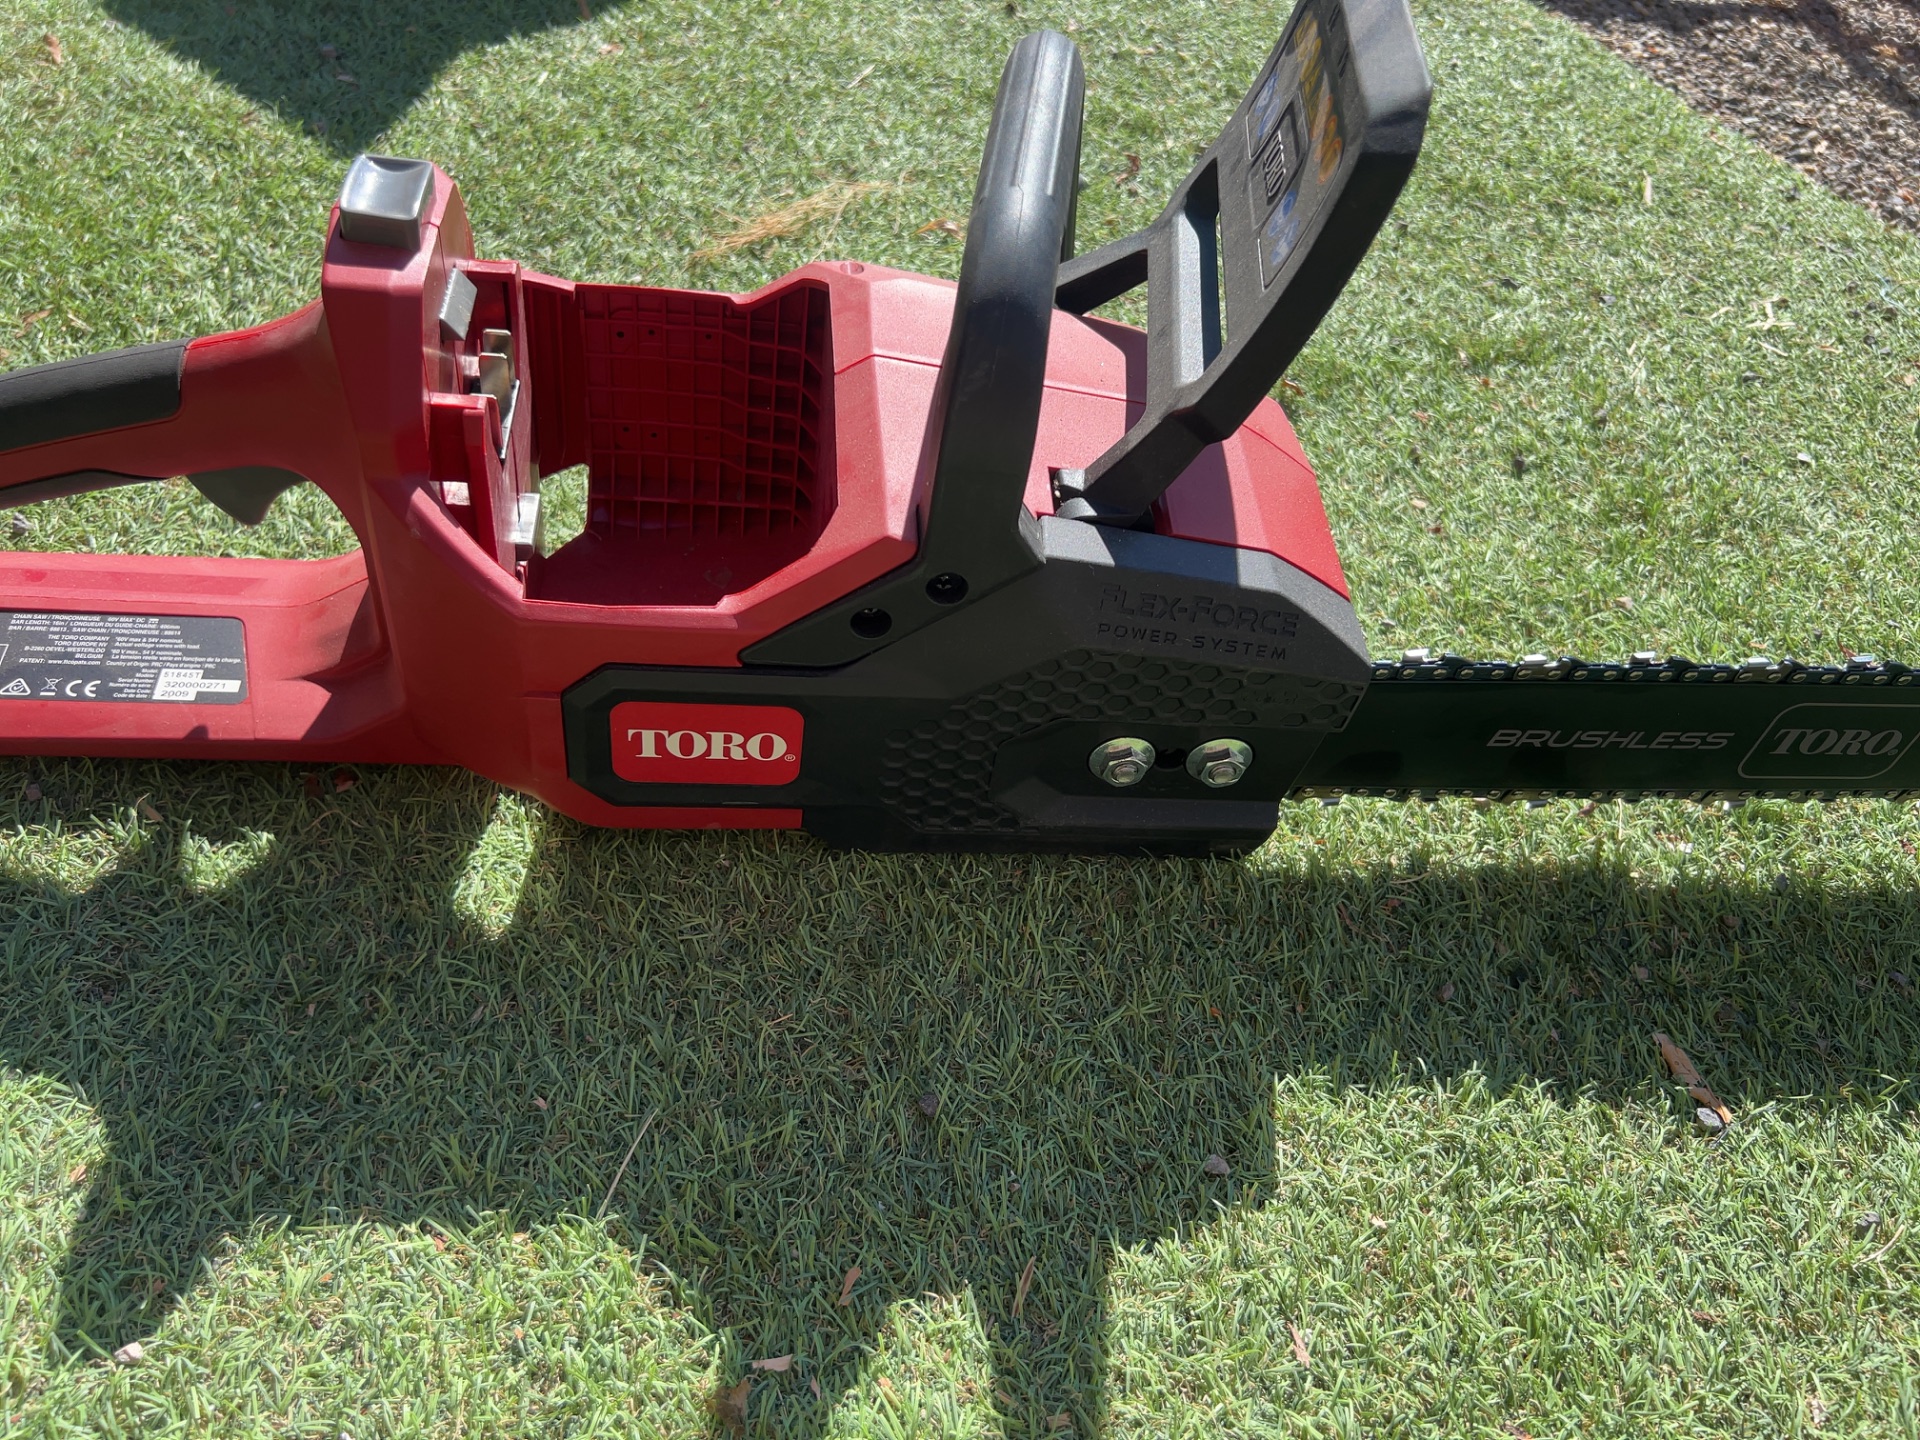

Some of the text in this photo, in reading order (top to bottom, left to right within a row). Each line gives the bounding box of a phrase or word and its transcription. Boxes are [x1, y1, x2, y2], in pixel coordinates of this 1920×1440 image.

[1100, 584, 1299, 638] FLEX-FORCE
[1097, 622, 1287, 661] POWER SYSTEM
[1487, 729, 1736, 750] BRUSHLESS
